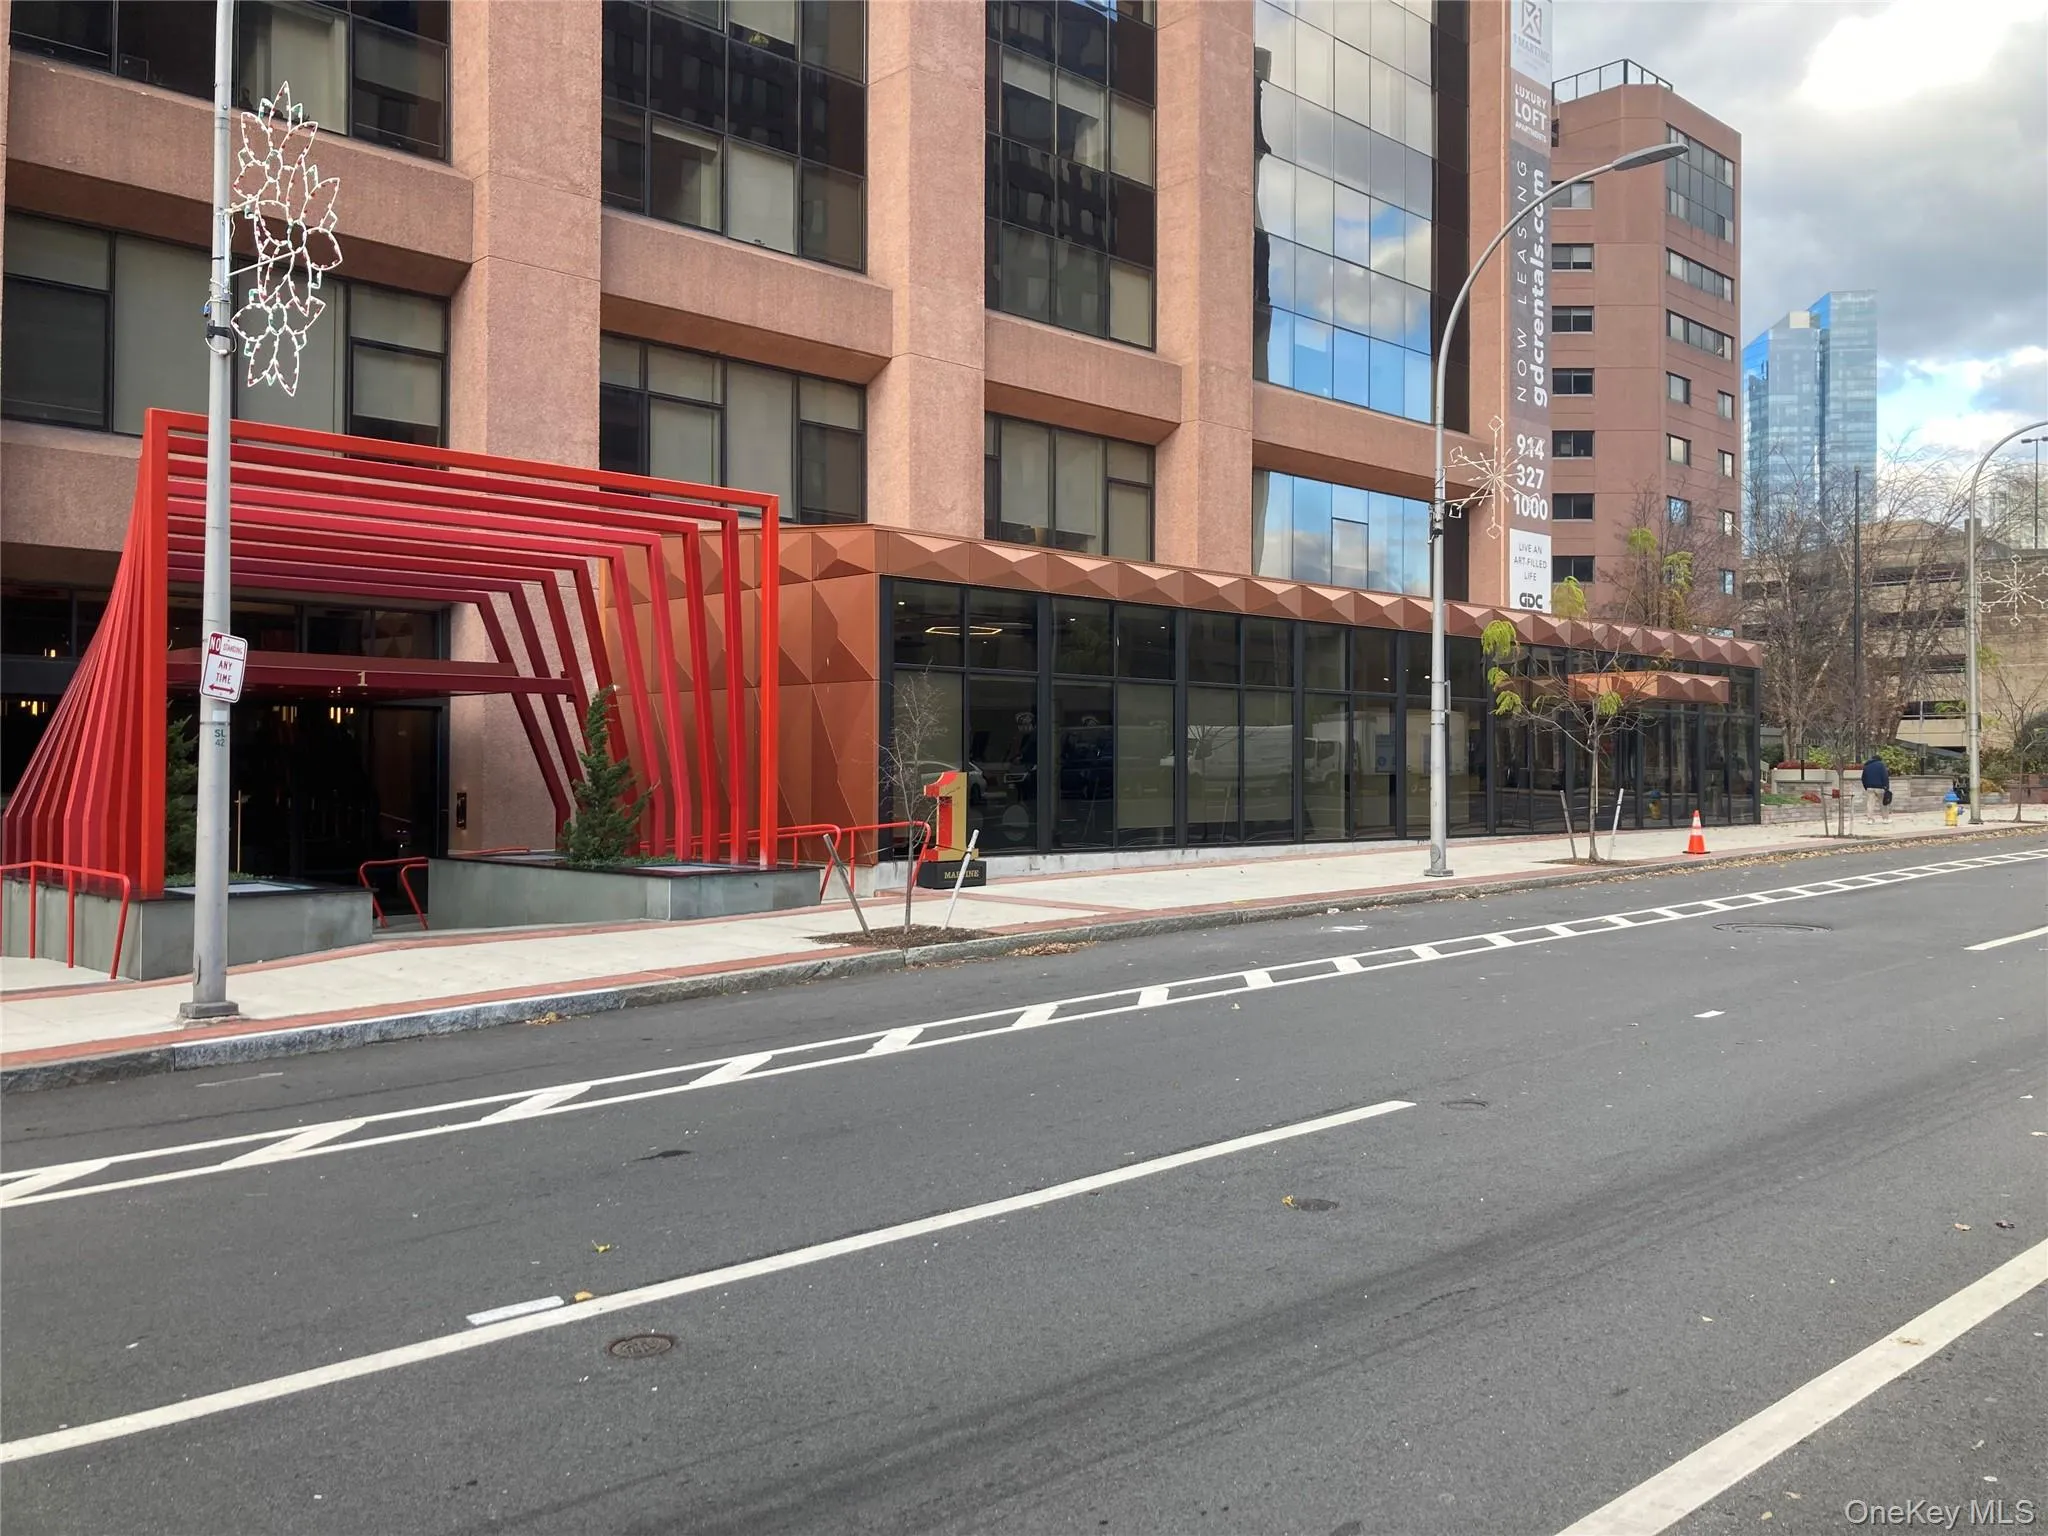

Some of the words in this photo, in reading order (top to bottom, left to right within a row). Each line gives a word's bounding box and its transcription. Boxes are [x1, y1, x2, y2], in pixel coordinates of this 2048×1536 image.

[1518, 36, 1550, 63] MARTINE
[1515, 84, 1547, 109] LUXURY
[1515, 98, 1547, 130] LOFT
[1515, 121, 1547, 143] APARTMENTS
[1516, 160, 1528, 304] LEASNG
[1530, 169, 1548, 407] gdcrentals.com
[1516, 328, 1528, 402] NOW
[1517, 434, 1545, 460] 914
[1516, 464, 1545, 489] 327
[1513, 493, 1548, 520] 1000
[1518, 543, 1532, 553] LIVE
[1533, 545, 1543, 554] AN
[1523, 571, 1537, 581] LIFE
[1519, 592, 1543, 609] GDC
[209, 636, 221, 652] NO
[222, 643, 244, 655] STANDING
[217, 659, 233, 671] ANY
[215, 672, 233, 685] TIME
[357, 670, 368, 687] 1
[214, 728, 226, 738] SL
[214, 738, 226, 748] 42
